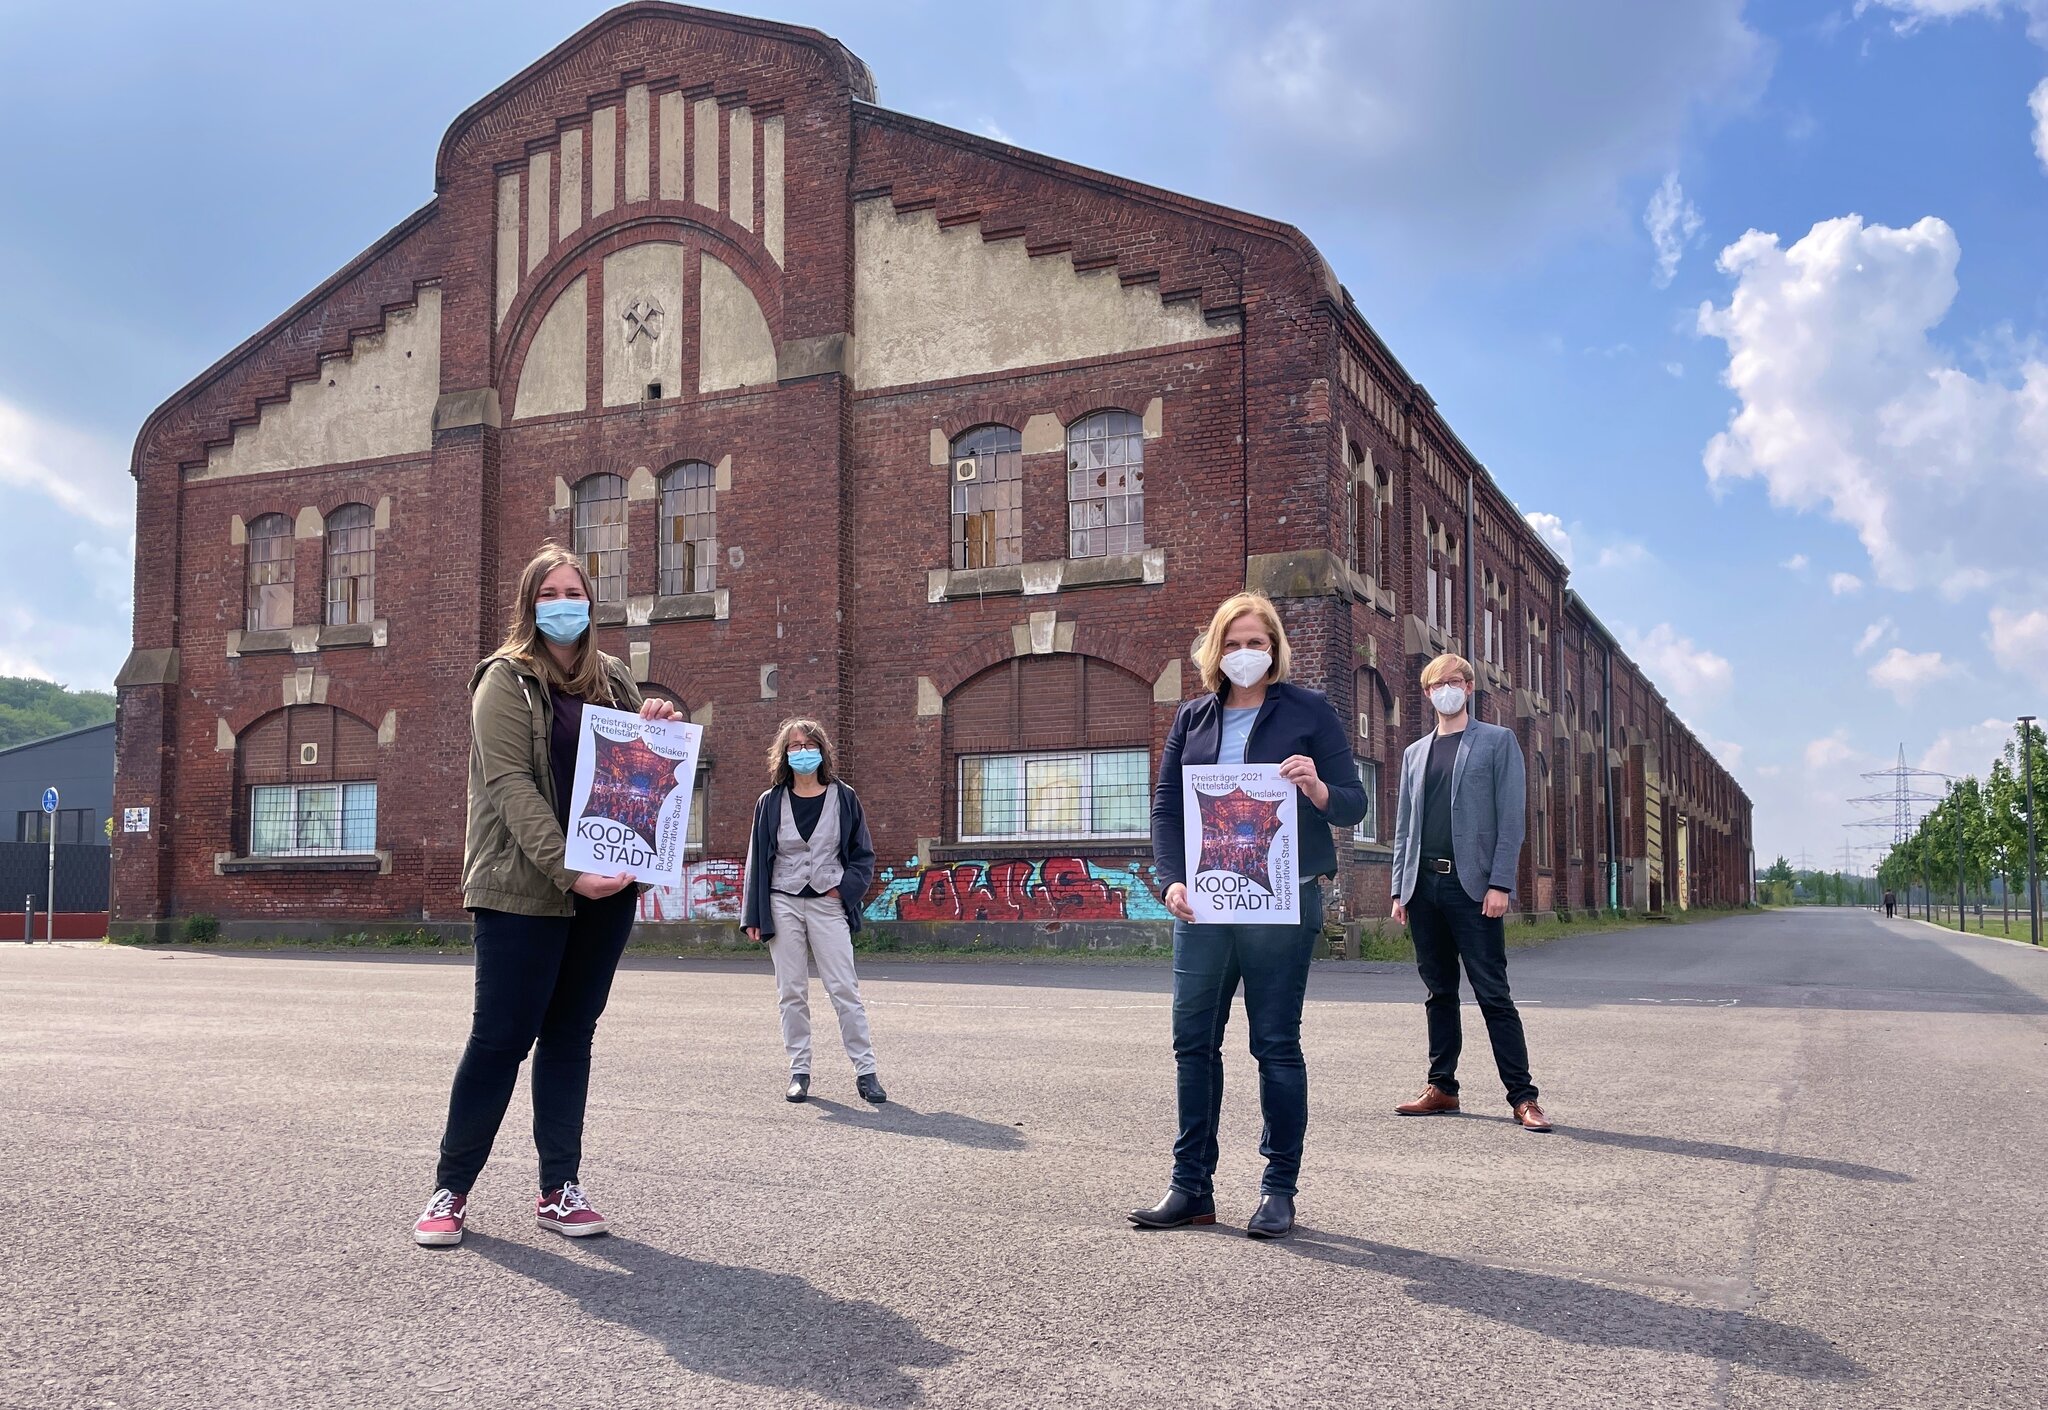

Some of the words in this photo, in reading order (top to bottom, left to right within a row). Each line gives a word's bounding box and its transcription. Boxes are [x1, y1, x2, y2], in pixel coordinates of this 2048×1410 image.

[590, 723, 640, 739] Mittelstadt
[591, 714, 641, 731] Preisträger
[645, 724, 666, 736] 2021
[647, 742, 688, 758] Dinslaken
[1191, 773, 1239, 783] Preisträger
[1241, 773, 1263, 781] 2021
[1191, 783, 1237, 791] Mittelstadt
[1246, 790, 1288, 798] Dinslaken
[672, 795, 683, 819] Stadt
[577, 820, 636, 847] KOOP.
[655, 816, 671, 871] Bundespreis
[593, 843, 656, 869] STADT
[665, 819, 680, 872] kooperative
[1282, 835, 1290, 859] Stadt
[1195, 876, 1251, 893] KOOP.
[1283, 860, 1291, 911] kooperative
[1212, 894, 1273, 911] STADT
